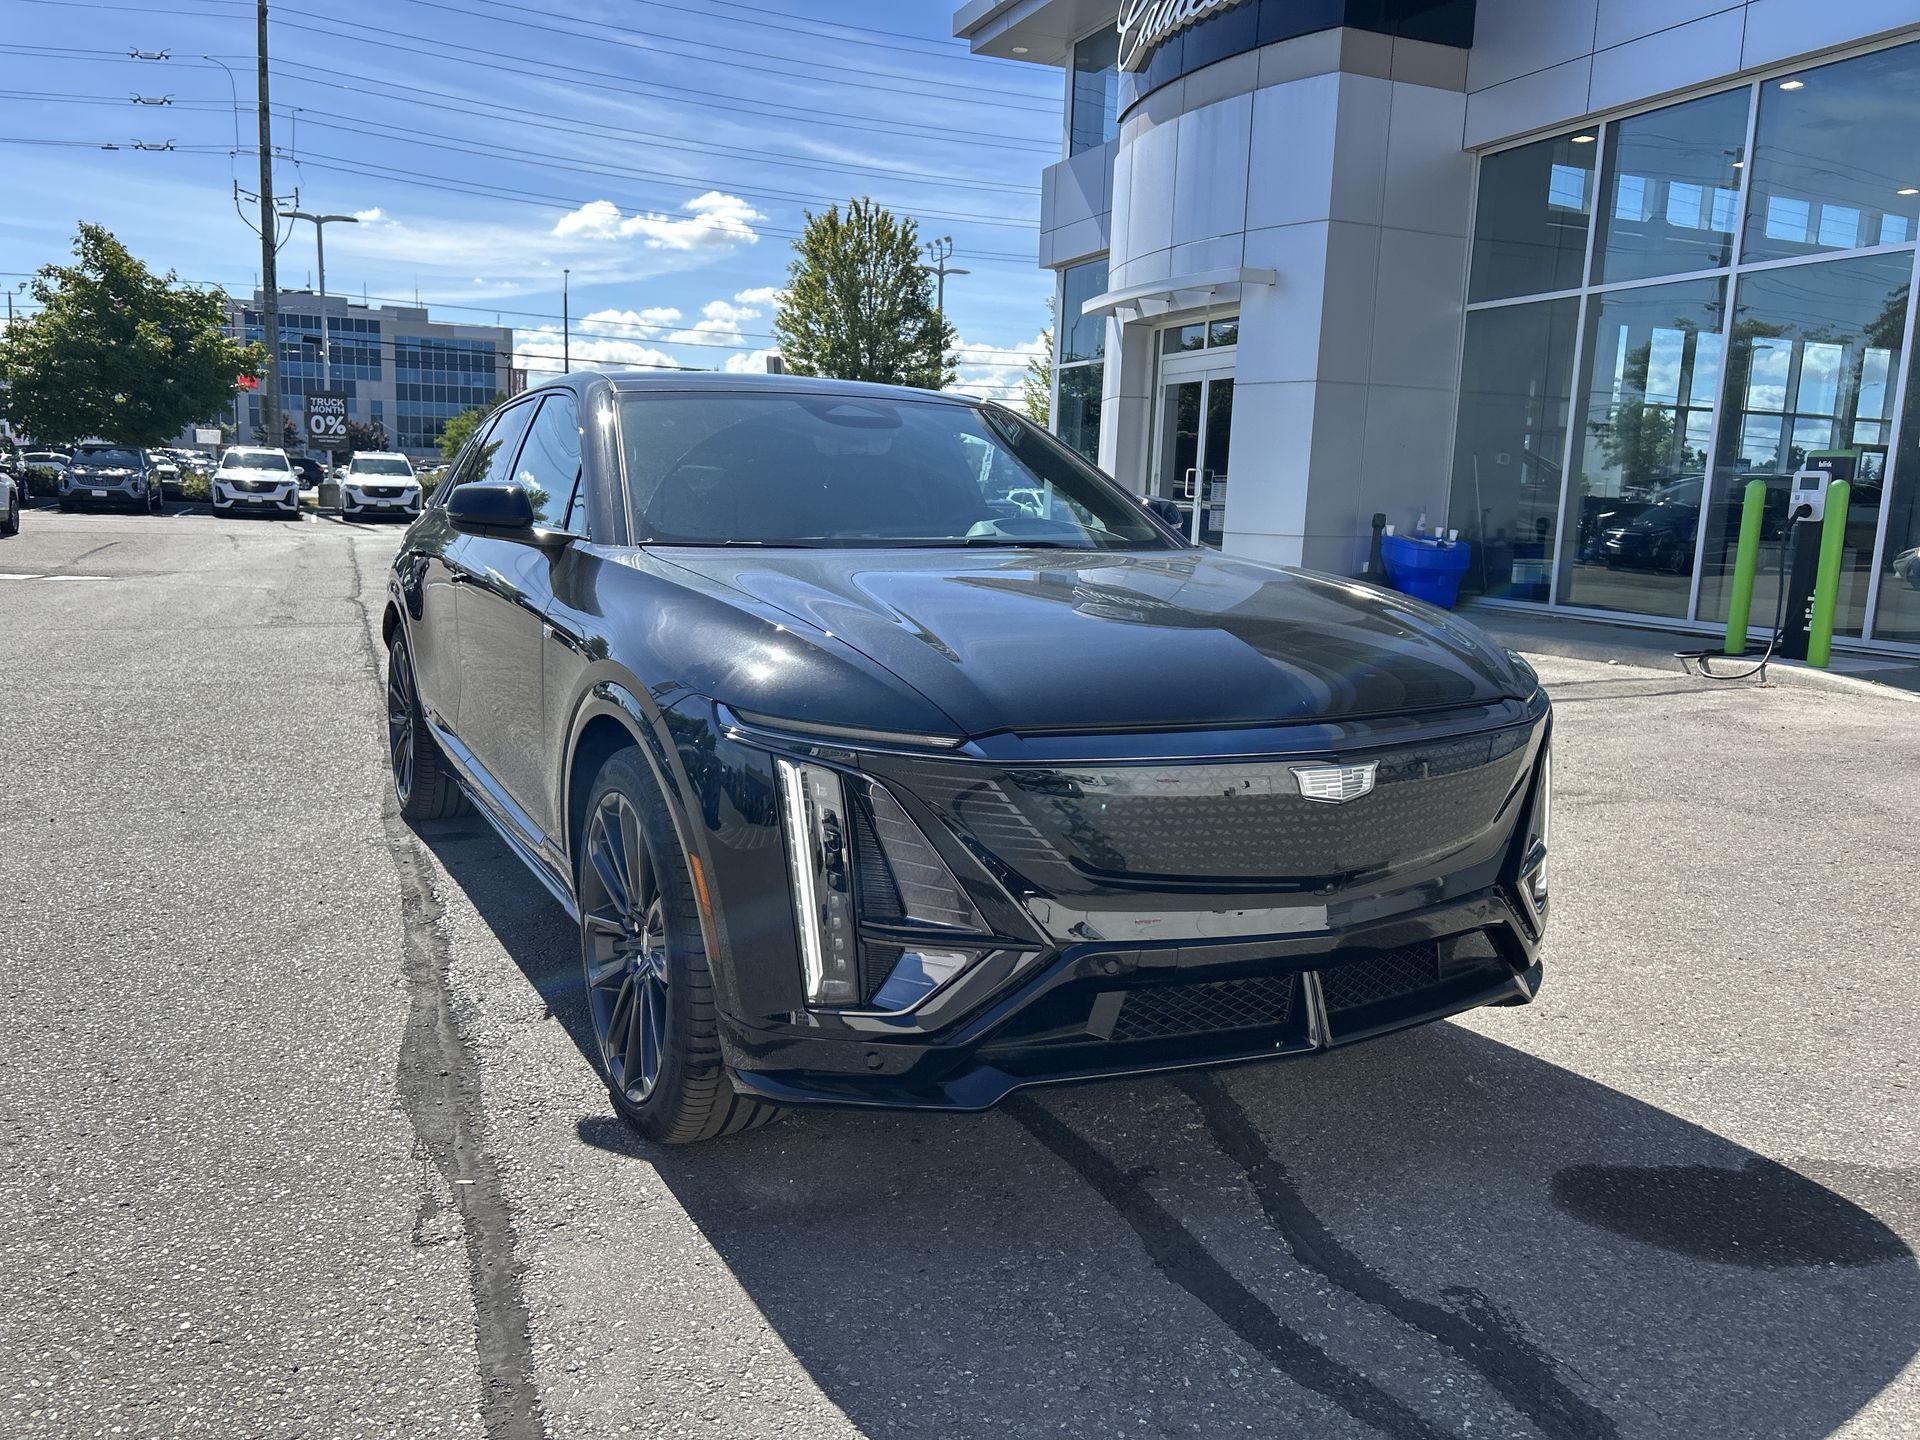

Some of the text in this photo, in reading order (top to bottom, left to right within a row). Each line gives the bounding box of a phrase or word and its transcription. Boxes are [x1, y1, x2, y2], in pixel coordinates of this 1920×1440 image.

[310, 397, 344, 406] TRUCK
[311, 405, 344, 414] MONTH
[311, 415, 346, 434] 0%
